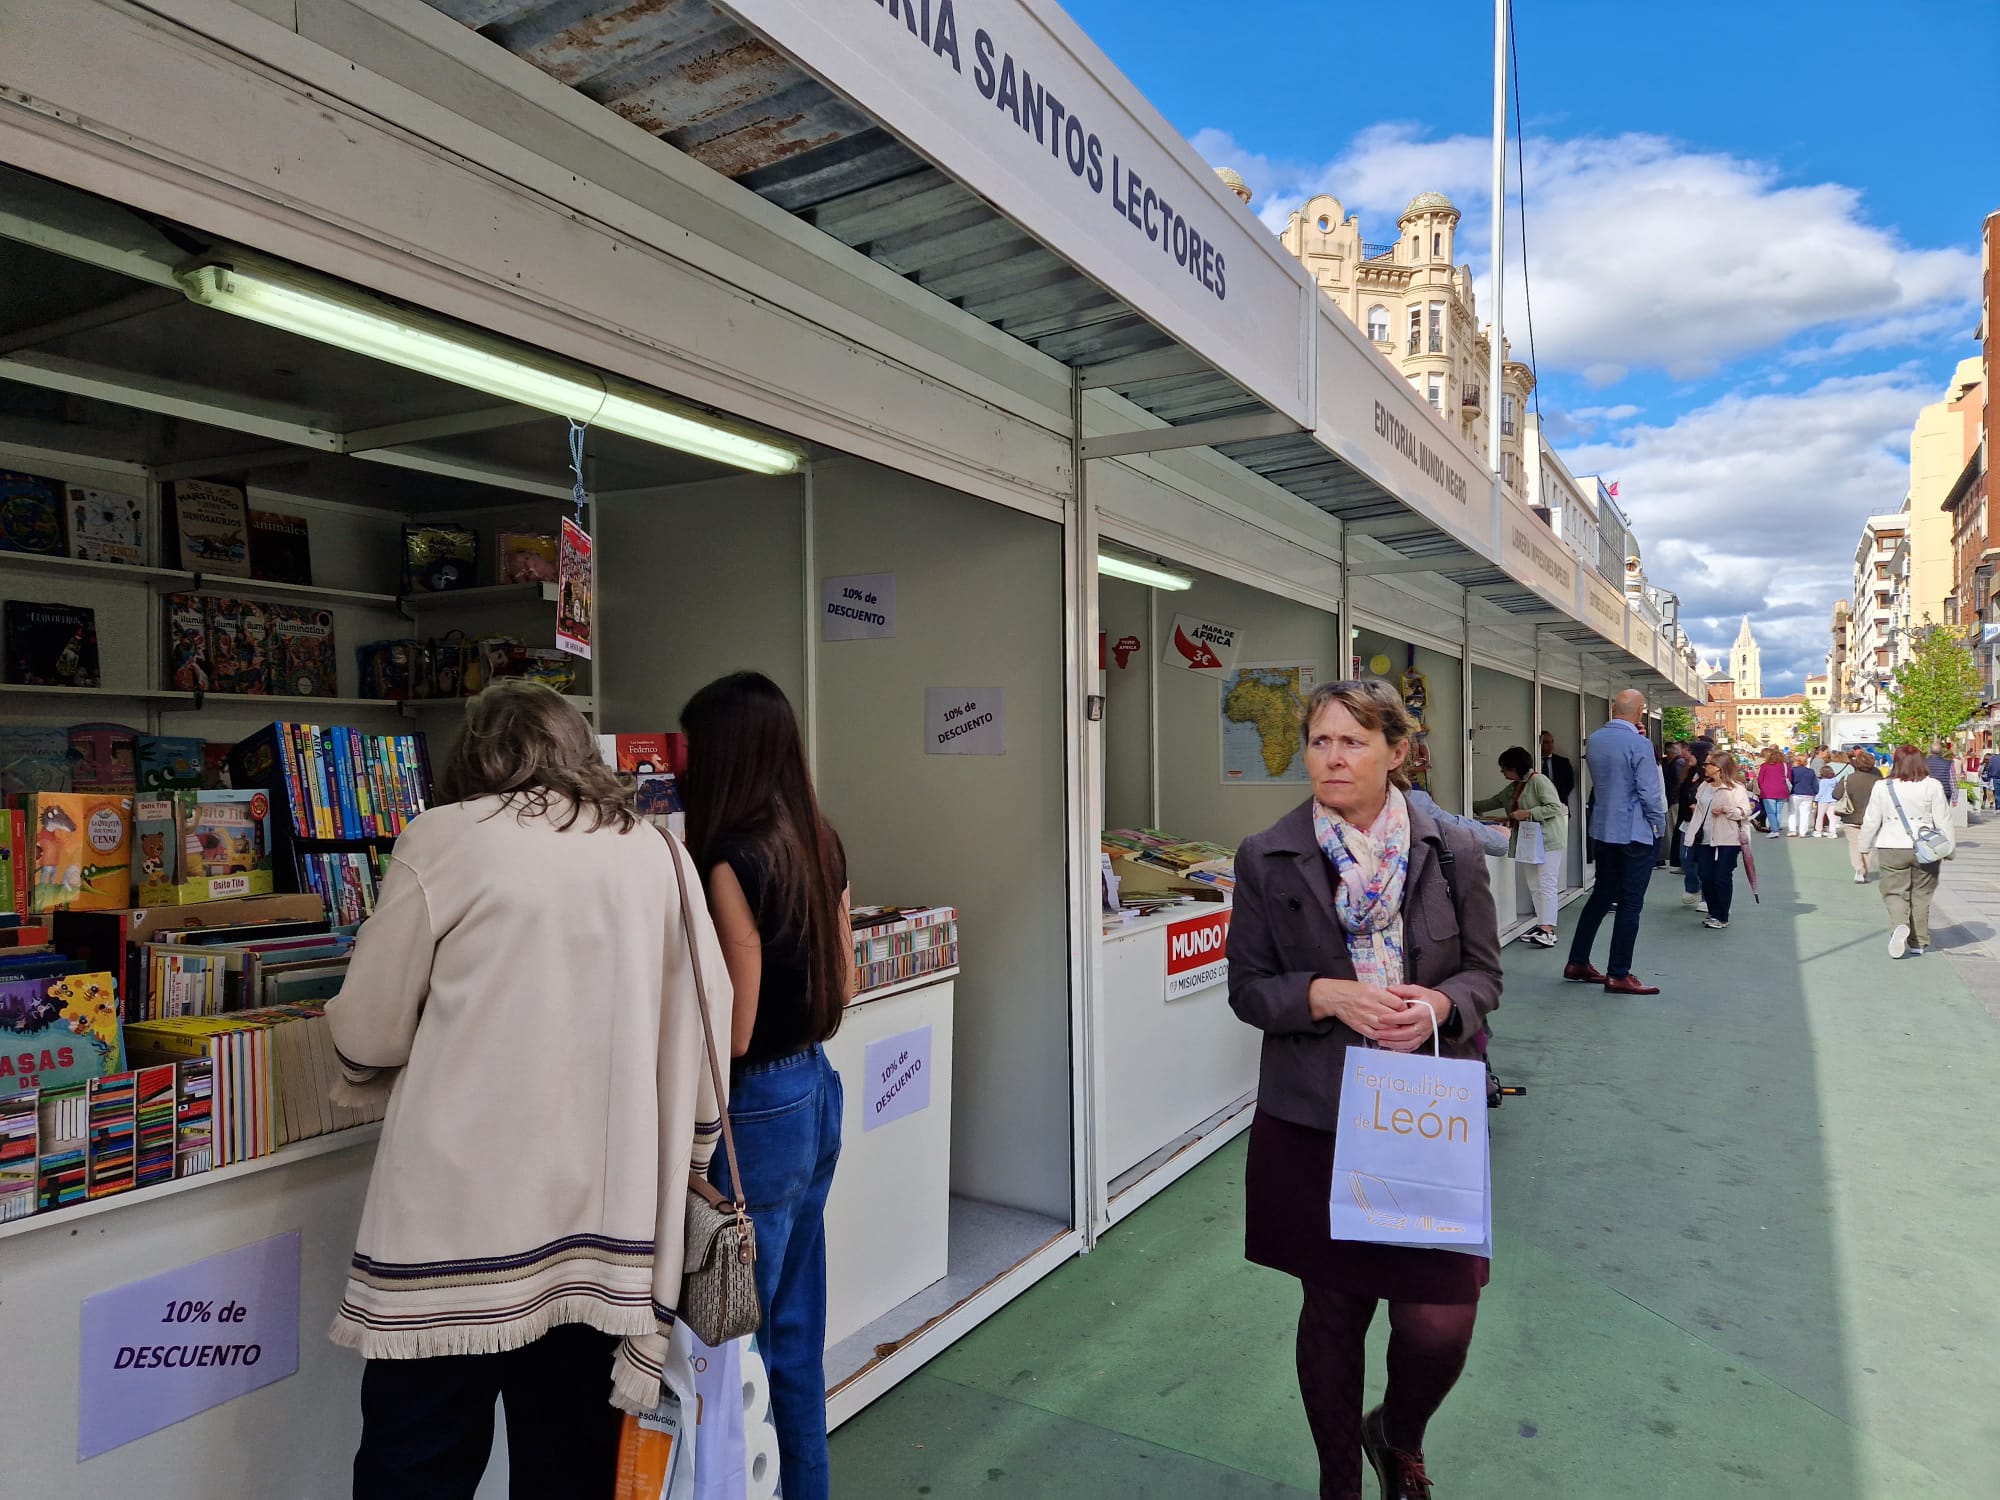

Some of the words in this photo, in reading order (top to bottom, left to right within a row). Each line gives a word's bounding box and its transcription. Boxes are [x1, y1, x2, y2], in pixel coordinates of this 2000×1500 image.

[974, 28, 1103, 194] SANTOS
[1113, 153, 1226, 301] LECTORES
[1374, 399, 1418, 466] EDITORIAL
[1419, 441, 1444, 487] MUNDO
[1446, 465, 1467, 504] NEGRO
[182, 511, 241, 527] DINOSAURIOS
[253, 518, 308, 535] animales
[842, 587, 863, 601] 10%
[864, 591, 878, 604] de
[827, 602, 886, 626] DESCUENTO
[278, 622, 326, 635] iluminatlas
[1192, 628, 1231, 647] ÁFRICA
[1202, 624, 1223, 635] MAPA
[1224, 629, 1235, 638] DE
[1193, 650, 1211, 665] 3€
[943, 706, 963, 722] 10%
[964, 700, 977, 713] de
[937, 712, 994, 744] DESCUENTO
[628, 745, 658, 754] Federico
[228, 807, 250, 820] Tito
[213, 879, 231, 891] Osito
[232, 878, 245, 889] Tito
[1172, 924, 1222, 961] MUNDO
[1178, 967, 1218, 992] MISIONEROS
[881, 1060, 898, 1084] 10%
[898, 1050, 909, 1065] de
[18, 1074, 41, 1089] DE
[874, 1059, 922, 1114] DESCUENTO
[1355, 1066, 1407, 1093] Feria
[1422, 1074, 1470, 1102] libro
[1353, 1112, 1371, 1129] de
[1373, 1090, 1469, 1144] León
[161, 1300, 213, 1323] 10%
[217, 1300, 247, 1323] de
[113, 1344, 262, 1370] DESCUENTO
